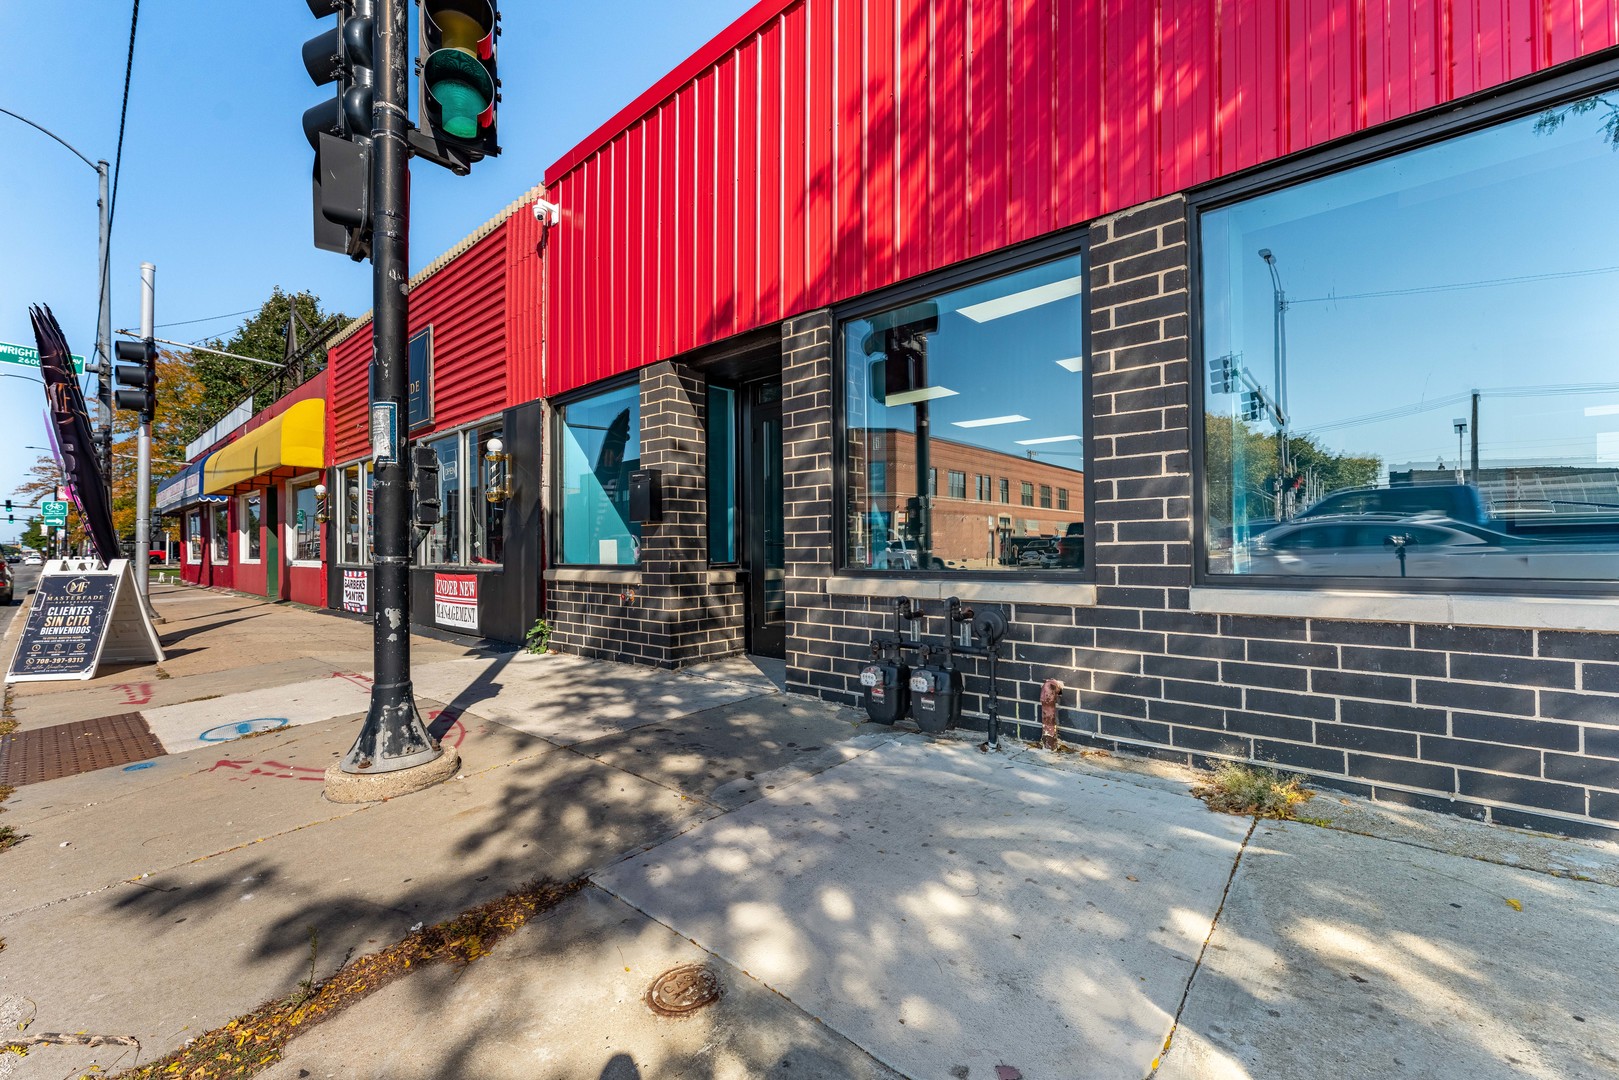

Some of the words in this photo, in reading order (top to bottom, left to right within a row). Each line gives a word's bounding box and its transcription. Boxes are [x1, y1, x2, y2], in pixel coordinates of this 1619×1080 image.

[344, 578, 366, 590] BARBERS
[436, 579, 458, 596] UNDER
[459, 581, 476, 597] NEW
[344, 589, 365, 602] WANTED
[47, 605, 94, 616] CLIENTES
[436, 603, 476, 623] MANAGEMENT
[44, 616, 64, 627] SIN
[66, 615, 90, 627] CITA
[40, 626, 91, 635] BIENVENIDOS
